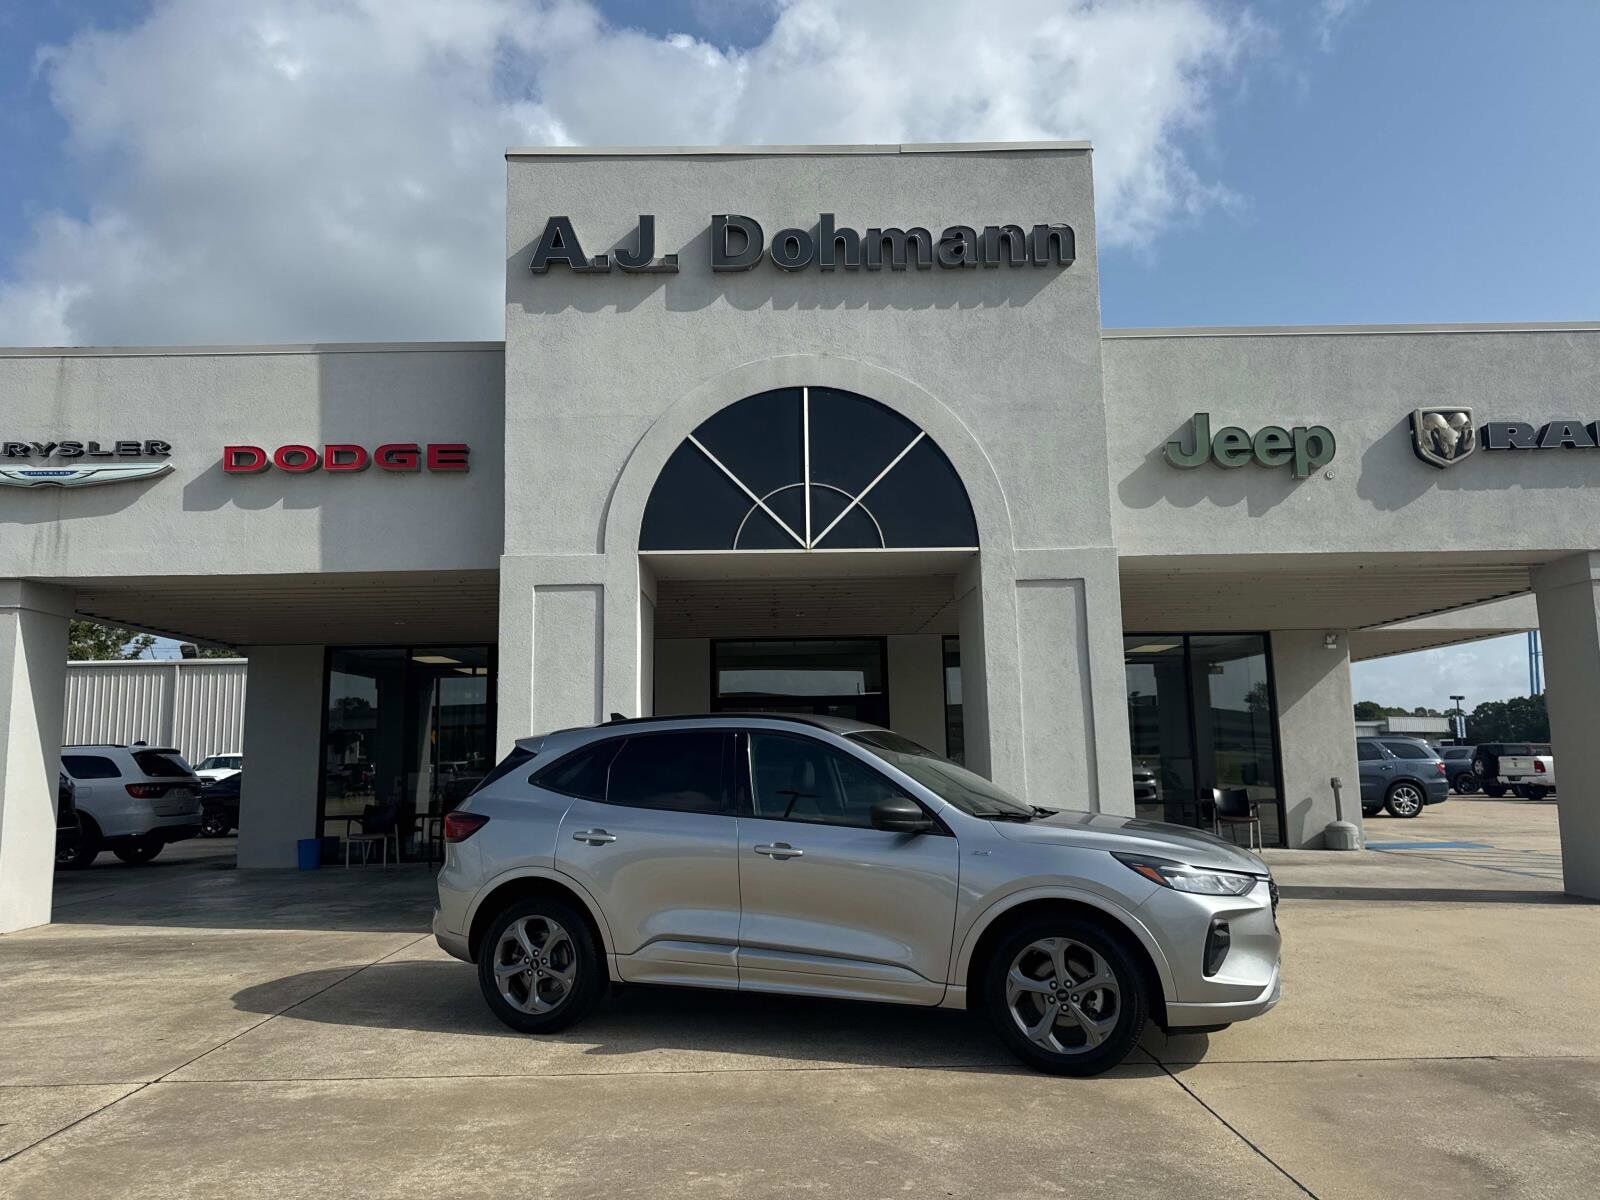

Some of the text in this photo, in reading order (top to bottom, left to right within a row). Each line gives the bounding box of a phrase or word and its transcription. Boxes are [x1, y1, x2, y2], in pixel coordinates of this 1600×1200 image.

[528, 212, 1077, 272] A.J. Dohmann
[1163, 412, 1337, 479] Jeep
[1481, 420, 1600, 449] RA
[223, 443, 471, 473] DODGE
